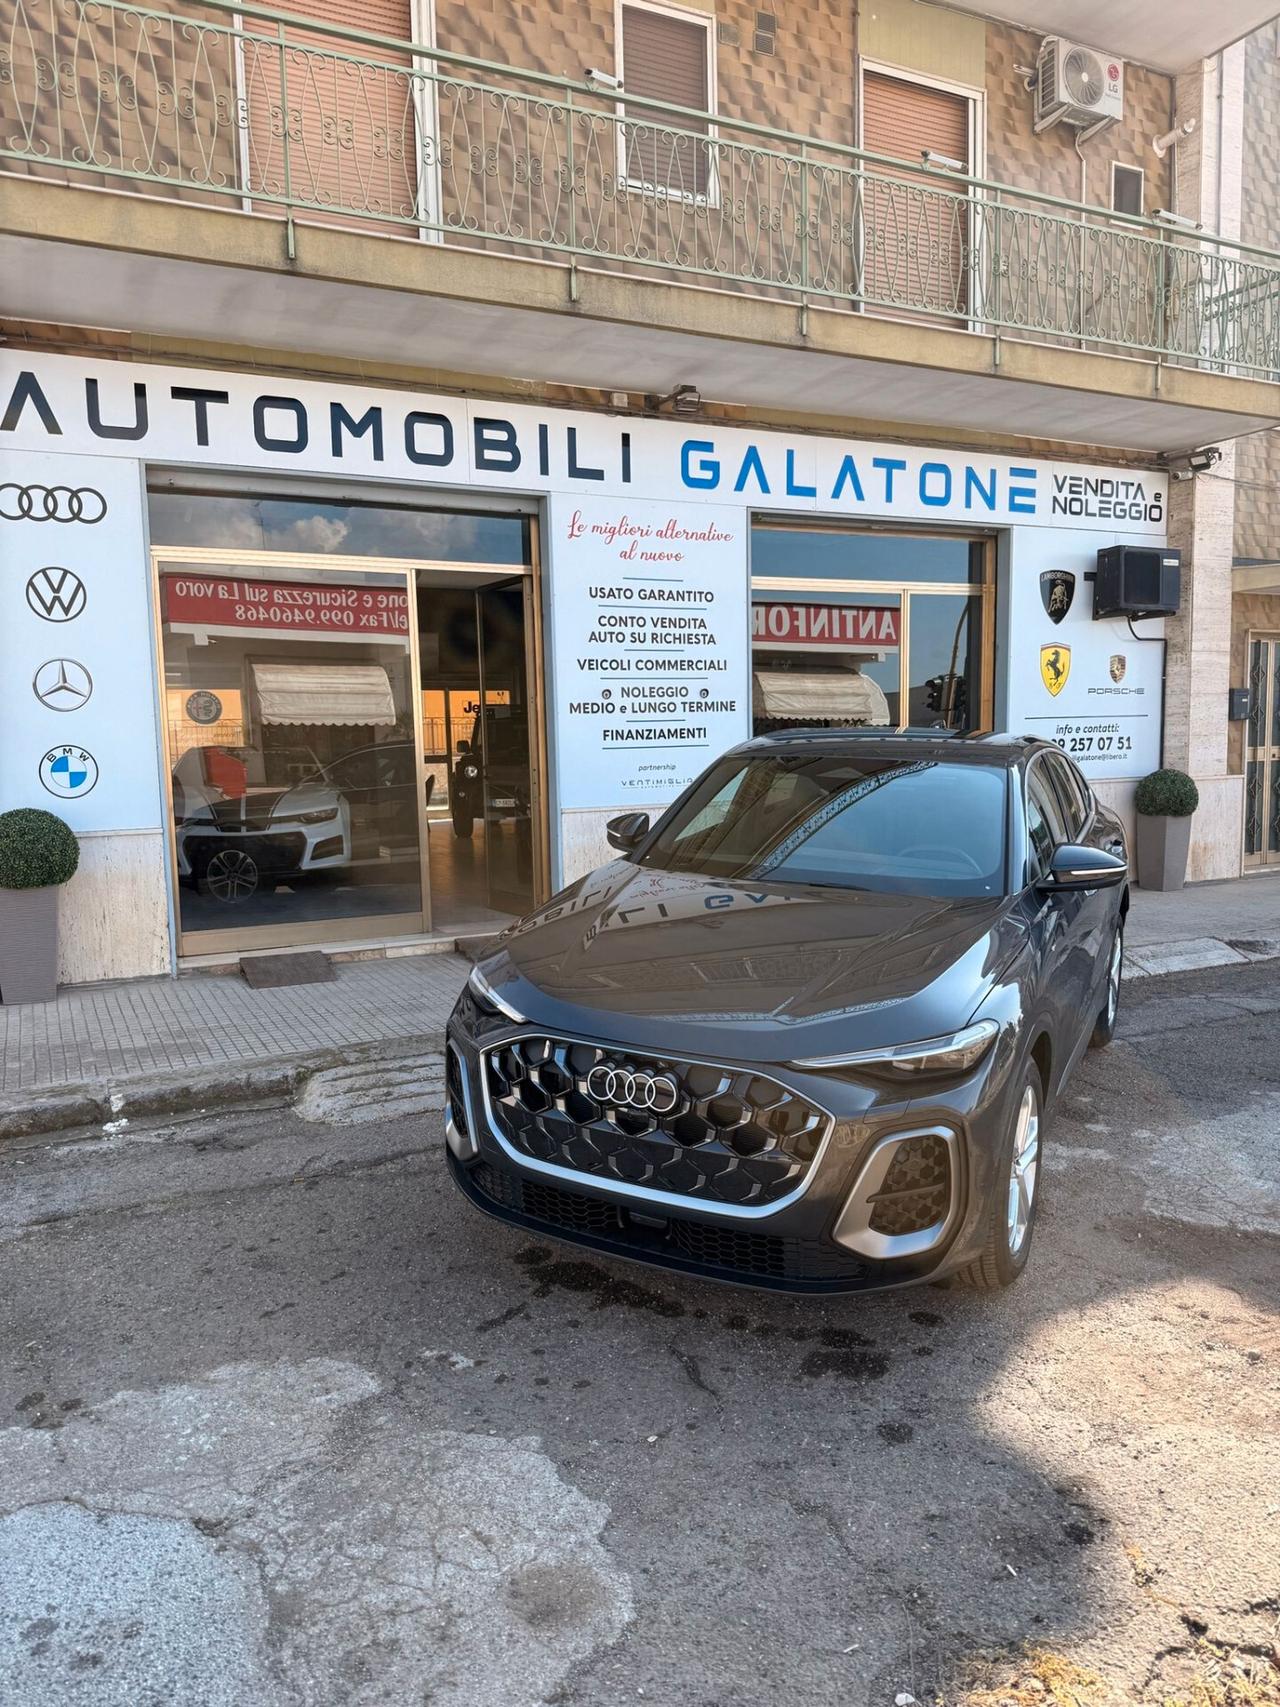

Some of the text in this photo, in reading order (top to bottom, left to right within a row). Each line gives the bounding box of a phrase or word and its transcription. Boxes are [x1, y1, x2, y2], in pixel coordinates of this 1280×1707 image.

[1108, 82, 1119, 93] LG
[0, 371, 1037, 514] AUTOMOBILI GALATONE
[1053, 474, 1162, 502] VENDITA e
[1052, 495, 1163, 522] NOLEGGIO
[567, 509, 734, 545] Le migliori alternative
[619, 540, 685, 562] al nuovo
[588, 586, 715, 603] USATO GARANTITO
[598, 615, 707, 630] CONTO VENDITA
[588, 631, 717, 645] AUTO SU RICHIESTA
[577, 658, 728, 671] VEICOLI COMMERCIALI
[620, 686, 689, 698] NOLEGGIO
[1087, 687, 1145, 695] PORSCHE
[569, 700, 736, 714] MEDIO e LUNGO TERMINE
[602, 727, 708, 741] FINANZIAMENTI
[1055, 723, 1120, 736] info e contatti:
[1051, 735, 1132, 752] 9 257 07 51
[46, 747, 90, 763] BMW
[638, 763, 677, 772] partnership
